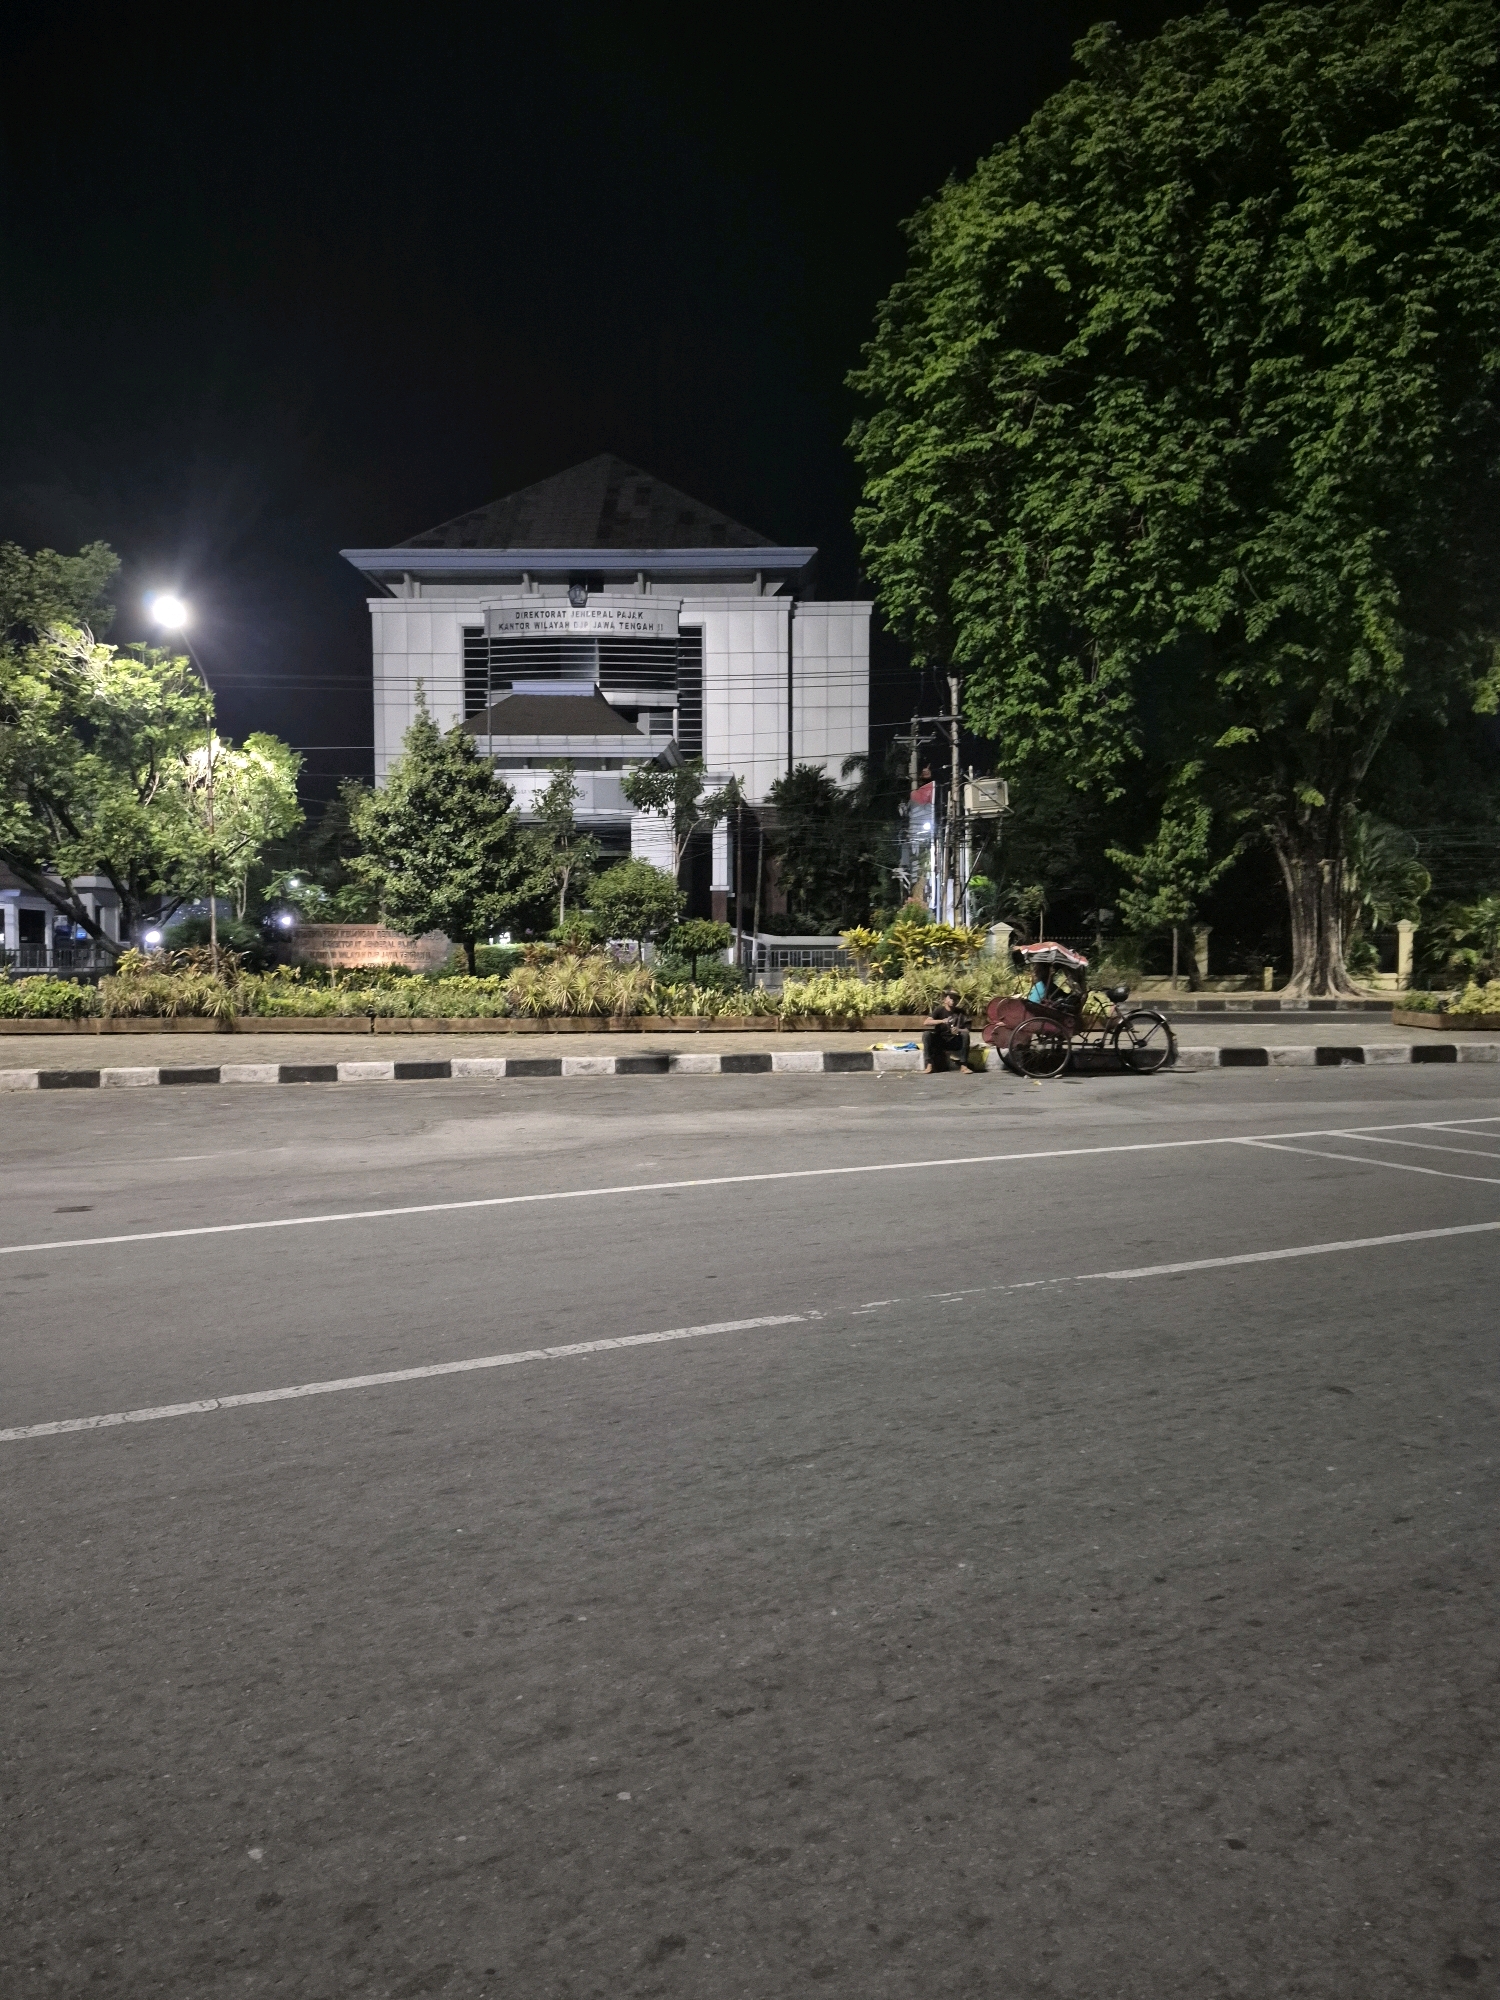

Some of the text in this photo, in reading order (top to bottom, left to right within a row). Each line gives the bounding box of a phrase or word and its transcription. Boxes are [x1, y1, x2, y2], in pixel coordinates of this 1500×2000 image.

[515, 610, 567, 620] DIREKTORAT
[616, 610, 644, 620] PAJAK
[498, 622, 530, 631] KANTOR
[533, 621, 570, 630] WILAYAH
[593, 621, 616, 630] JAWA
[619, 621, 654, 631] TENGAH
